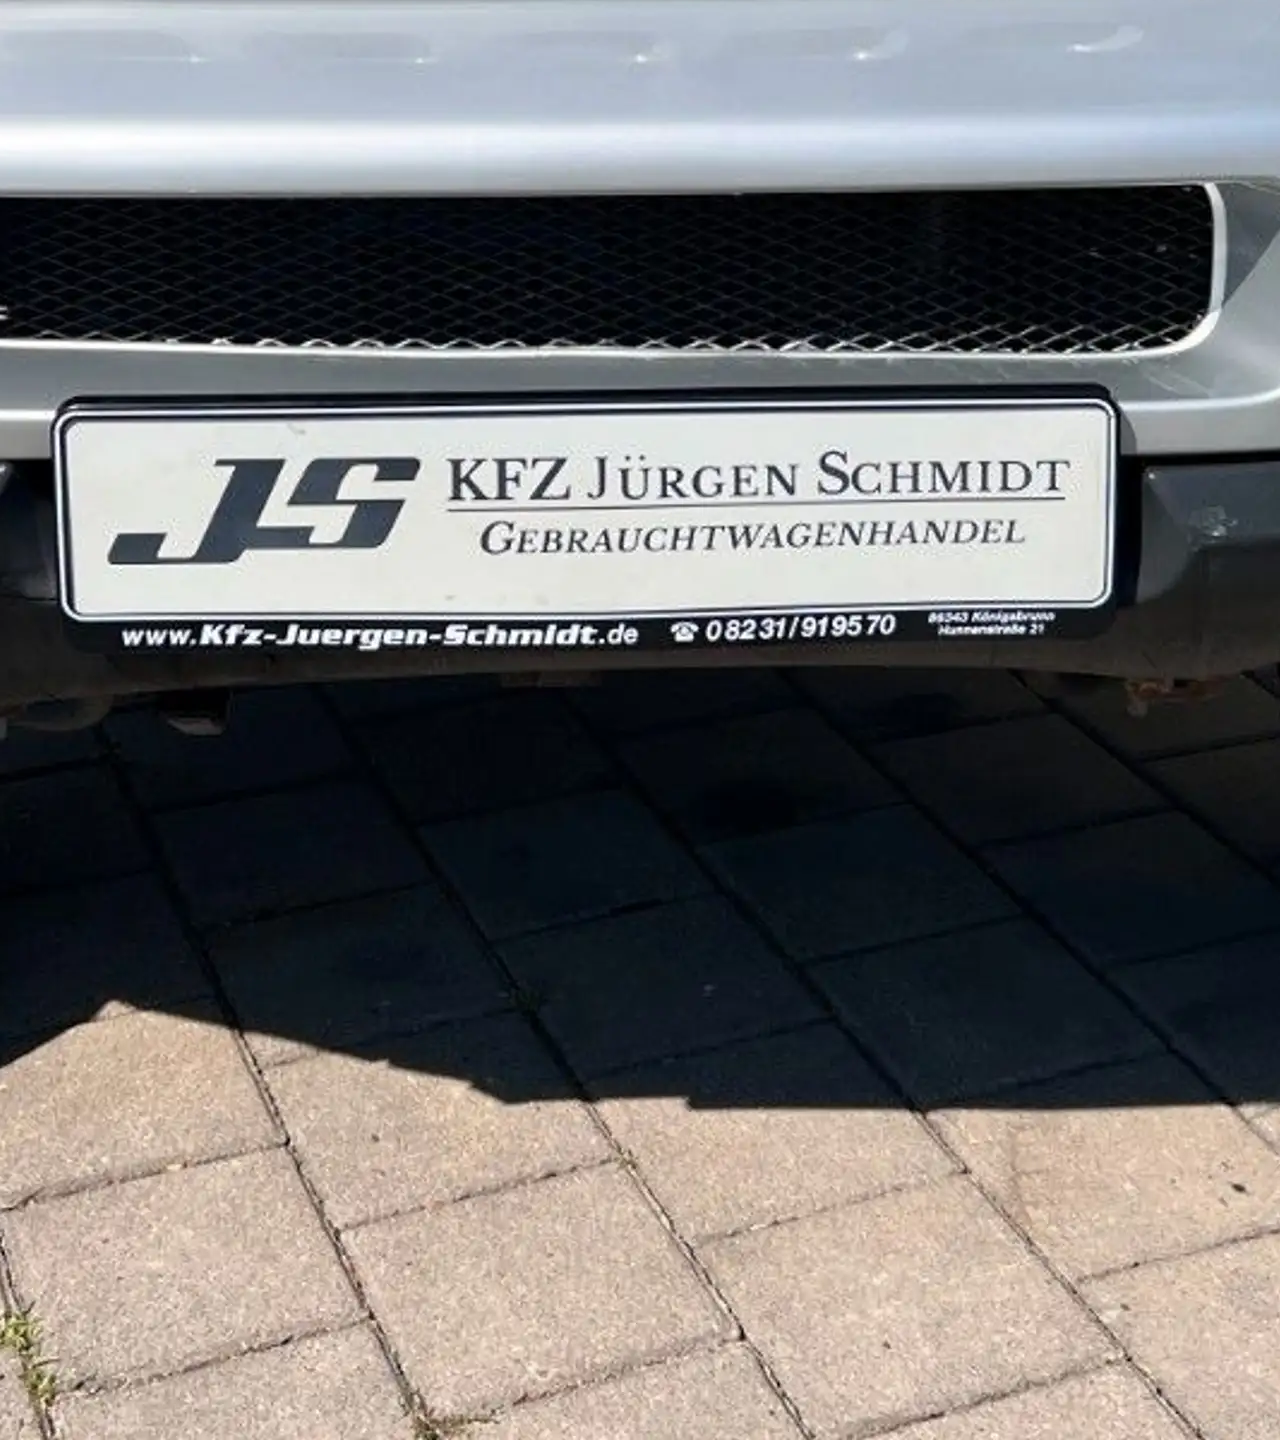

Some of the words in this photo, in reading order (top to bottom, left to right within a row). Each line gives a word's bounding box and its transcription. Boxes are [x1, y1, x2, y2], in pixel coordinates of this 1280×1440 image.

[446, 456, 571, 501] KFZ
[107, 457, 421, 565] JS
[121, 622, 639, 651] www.Kfz-Juergen-Schmidt.de
[705, 613, 897, 642] 08231/919570
